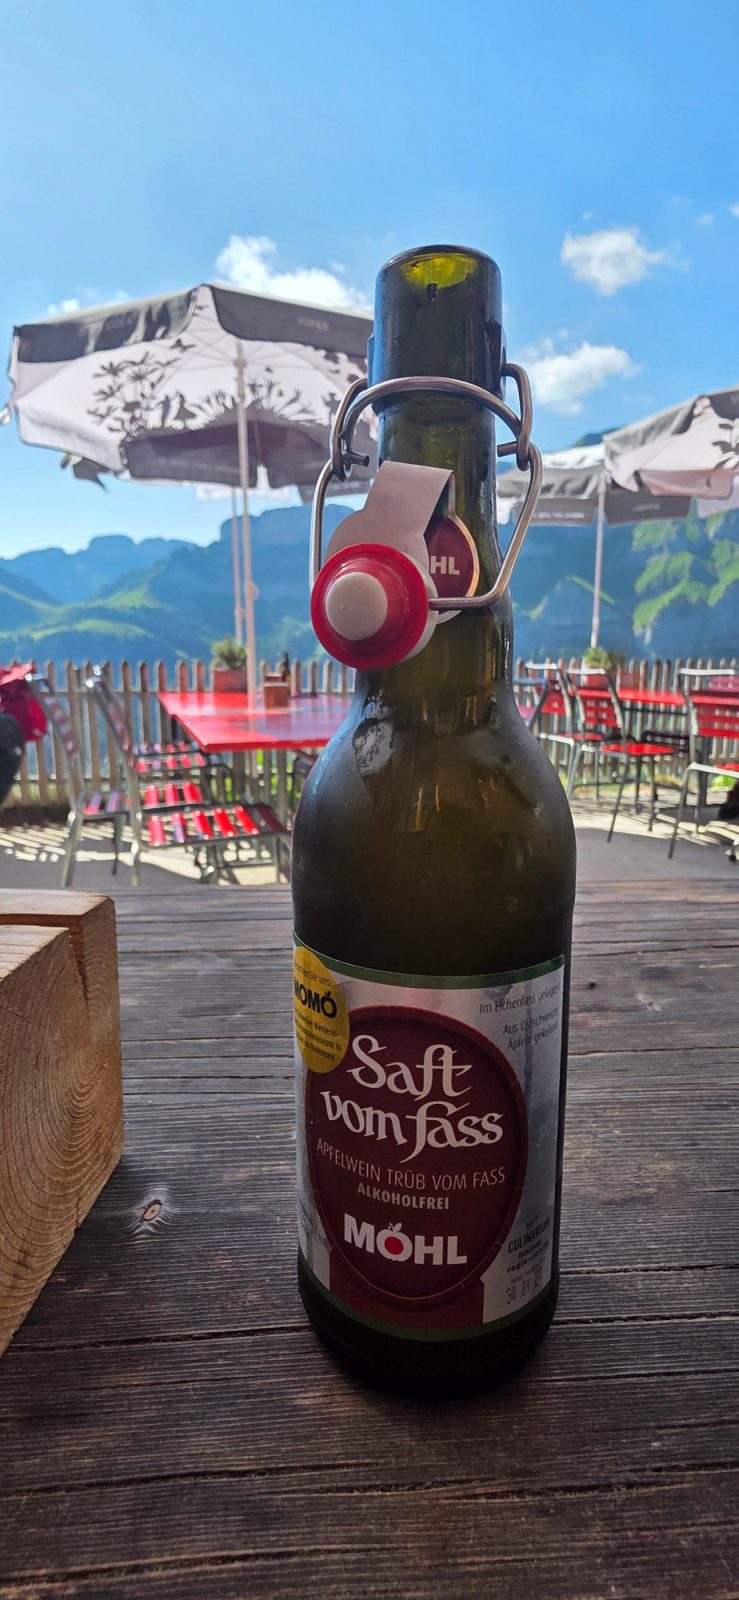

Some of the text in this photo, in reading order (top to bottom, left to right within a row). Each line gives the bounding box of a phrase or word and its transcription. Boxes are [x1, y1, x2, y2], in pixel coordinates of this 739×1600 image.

[430, 555, 460, 575] HL
[480, 1003, 492, 1014] Im
[503, 1023, 518, 1036] Aus
[346, 1034, 473, 1101] Saft
[316, 1138, 505, 1191] APFELWEIN TRÜB VOM FASS
[357, 1182, 449, 1211] ALKOHOLFREI
